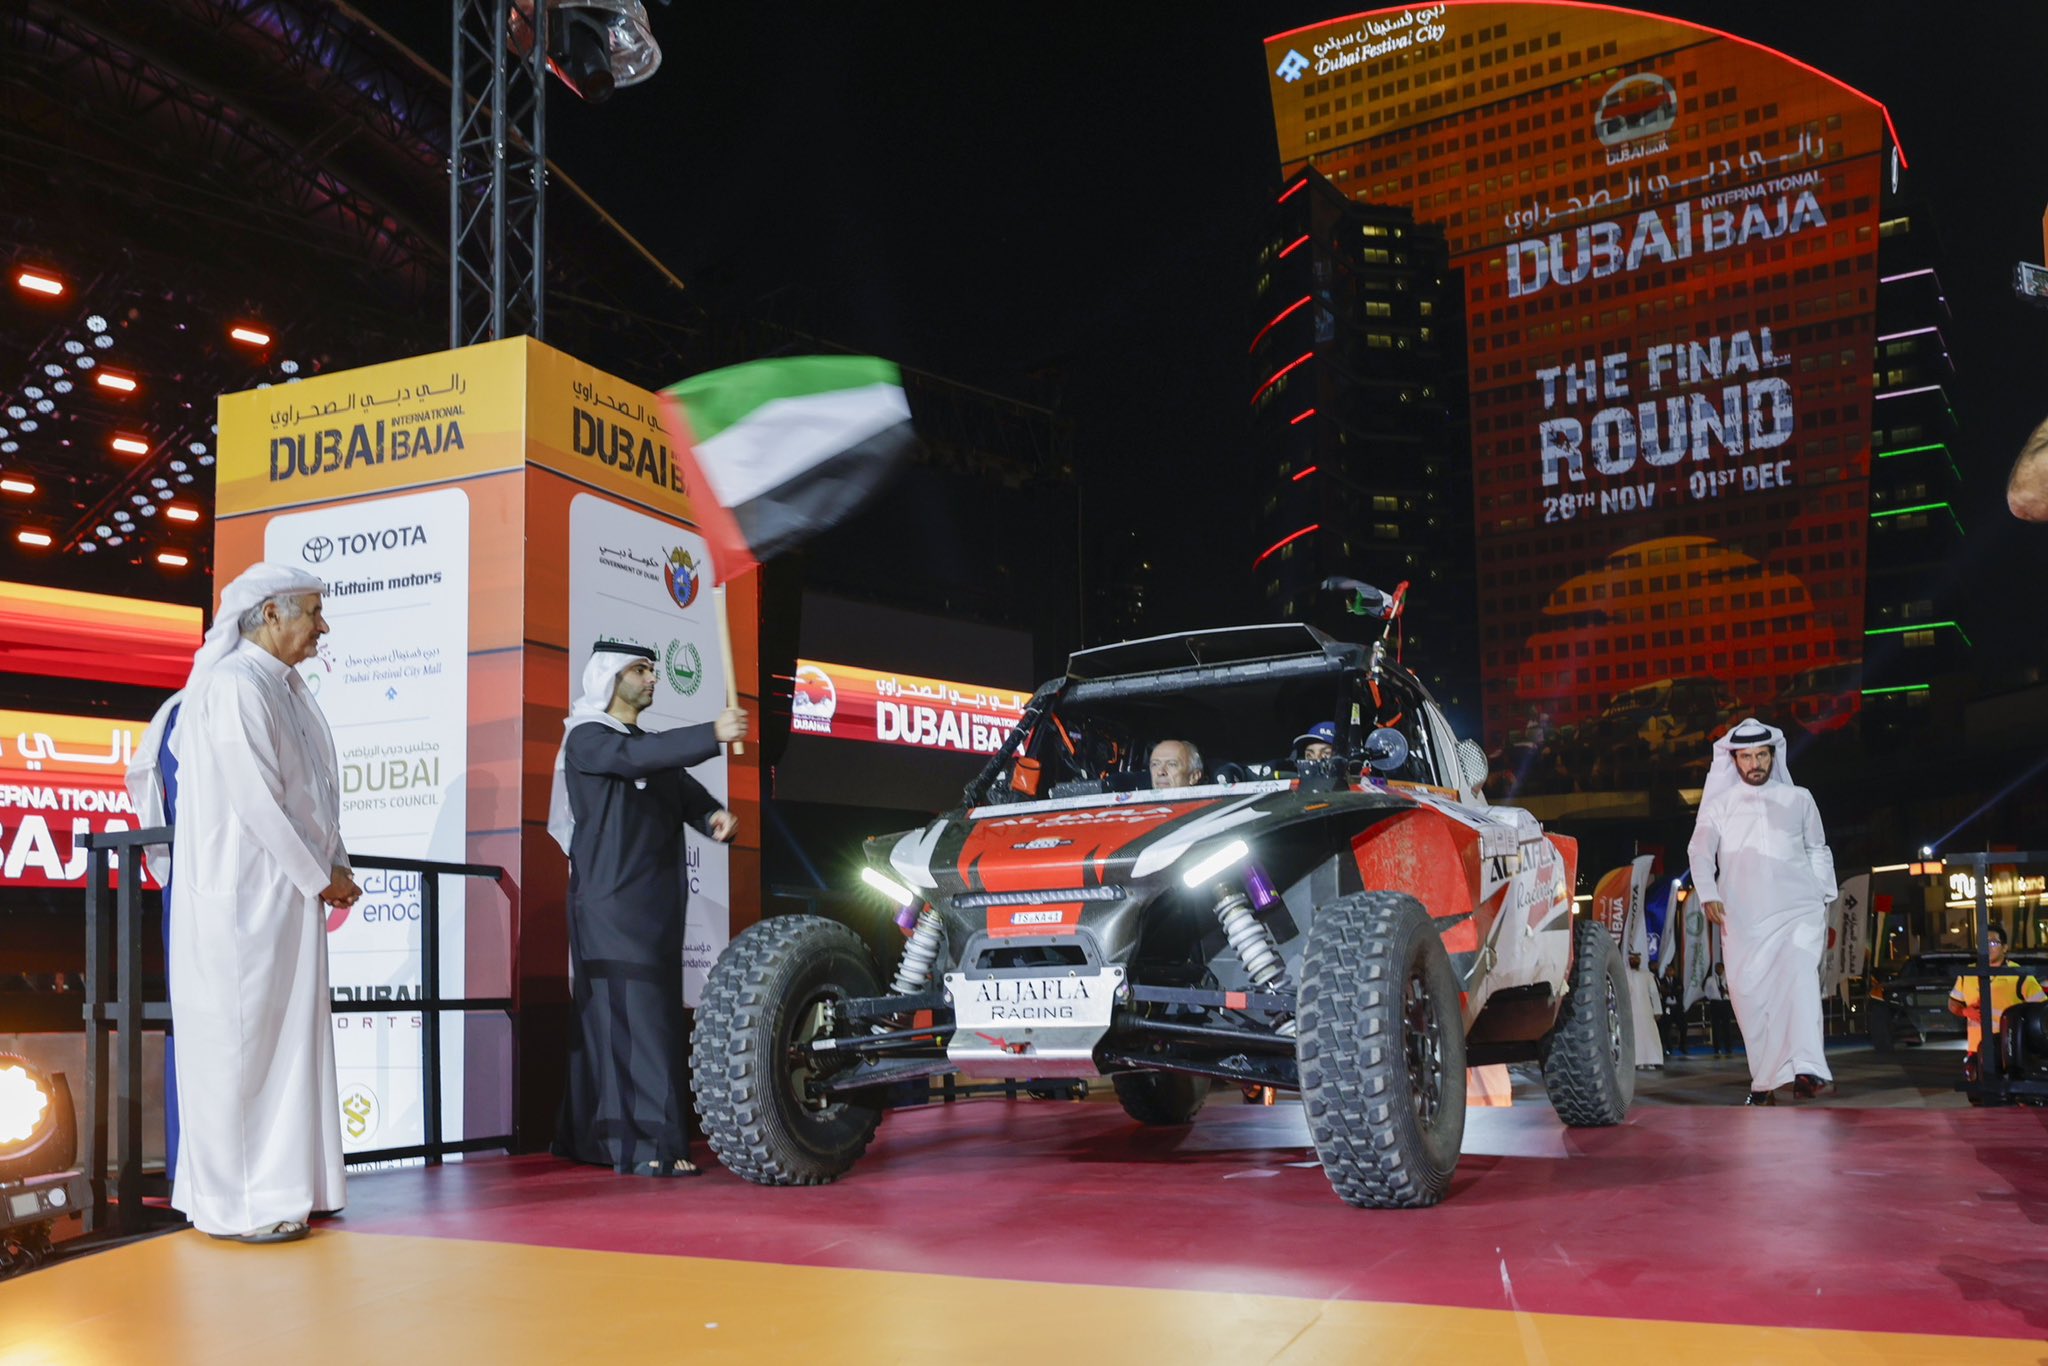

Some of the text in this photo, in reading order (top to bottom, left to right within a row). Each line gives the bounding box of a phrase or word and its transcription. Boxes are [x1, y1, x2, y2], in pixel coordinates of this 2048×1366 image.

[1416, 3, 1446, 25] دبي
[1314, 24, 1446, 76] Dubai Festival City
[1648, 160, 1731, 198] دبي
[1701, 170, 1825, 210] INTERNATIONAL
[1504, 176, 1640, 234] الصحراوي
[1507, 190, 1827, 298] DUBAI BAJA
[1536, 326, 1788, 410] THE FINAL
[270, 373, 466, 430] رالي دبي الصحراوي
[391, 405, 465, 427] INTERNATIONAL
[573, 380, 644, 423] الصحراوي
[270, 419, 465, 482] DUBAI BAJA
[573, 406, 667, 487] DUBAI
[1539, 377, 1794, 486] ROUND
[1601, 482, 1655, 514] NOV
[1742, 460, 1792, 491] DEC
[338, 525, 427, 556] TOYOTA
[388, 571, 442, 589] motors
[599, 557, 635, 574] GOVERNMENT
[644, 571, 659, 581] DUBAI
[343, 663, 442, 684] Dubai Festival City Mall
[876, 677, 946, 700] الصحراوي
[876, 700, 970, 750] DUBAI
[342, 757, 439, 793] DUBAI
[343, 794, 439, 811] SPORTS COUNCIL
[363, 903, 420, 923] enoc
[1612, 897, 1624, 931] BAJA
[337, 1017, 421, 1029] ORTS
